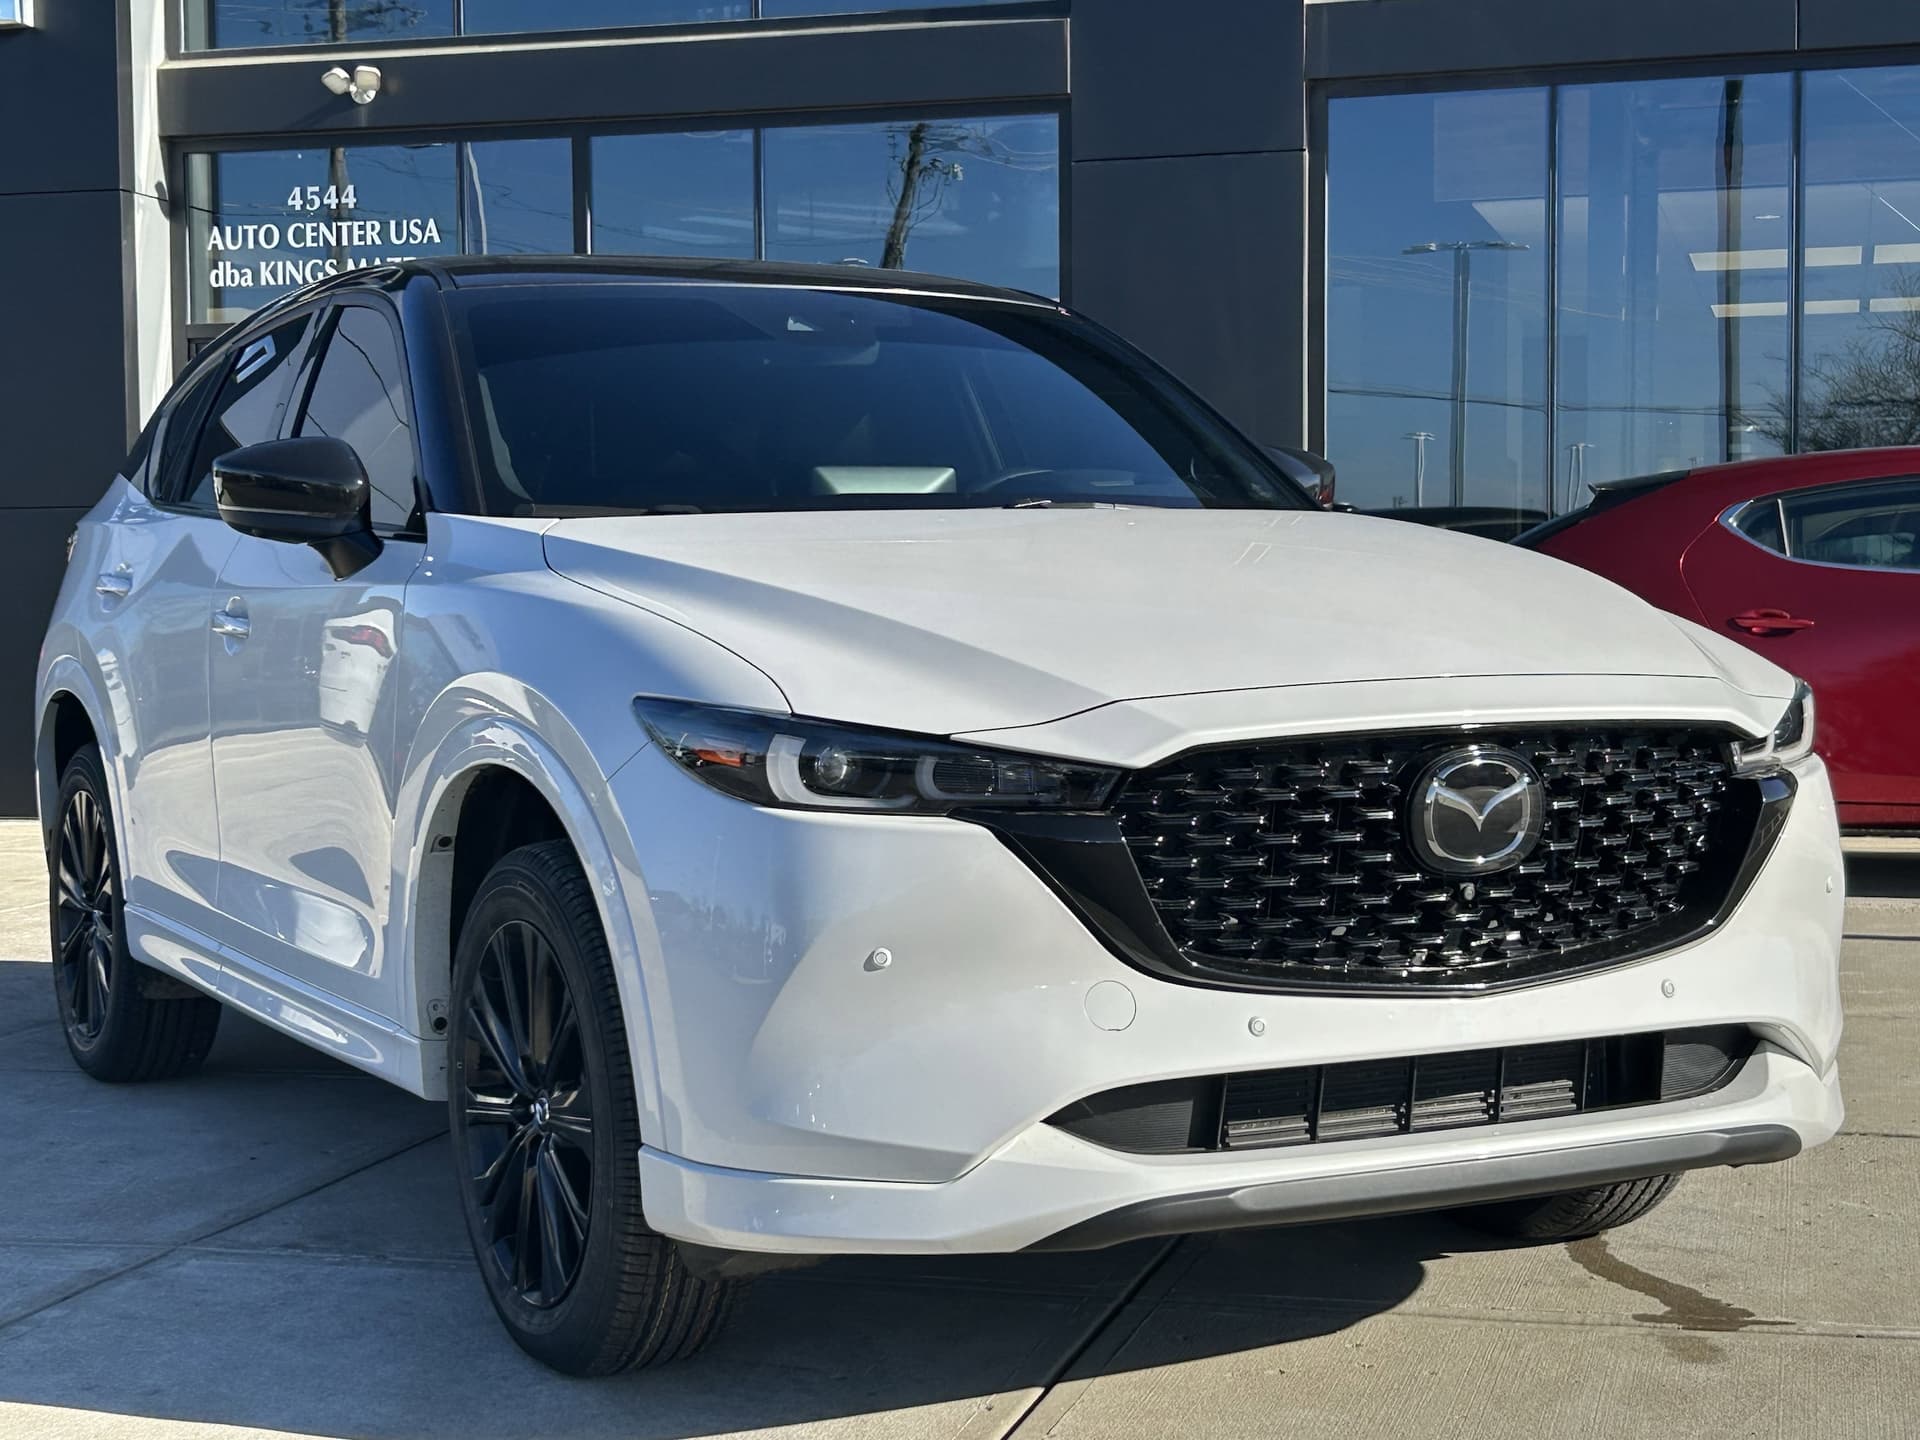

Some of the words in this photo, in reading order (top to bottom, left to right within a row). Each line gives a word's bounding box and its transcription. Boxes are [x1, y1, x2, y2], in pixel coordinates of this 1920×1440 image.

[287, 184, 357, 211] 4544
[207, 224, 280, 251] AUTO
[287, 220, 382, 249] CENTER
[389, 217, 441, 244] USA
[209, 260, 254, 288] dba
[259, 258, 338, 286] KINGS
